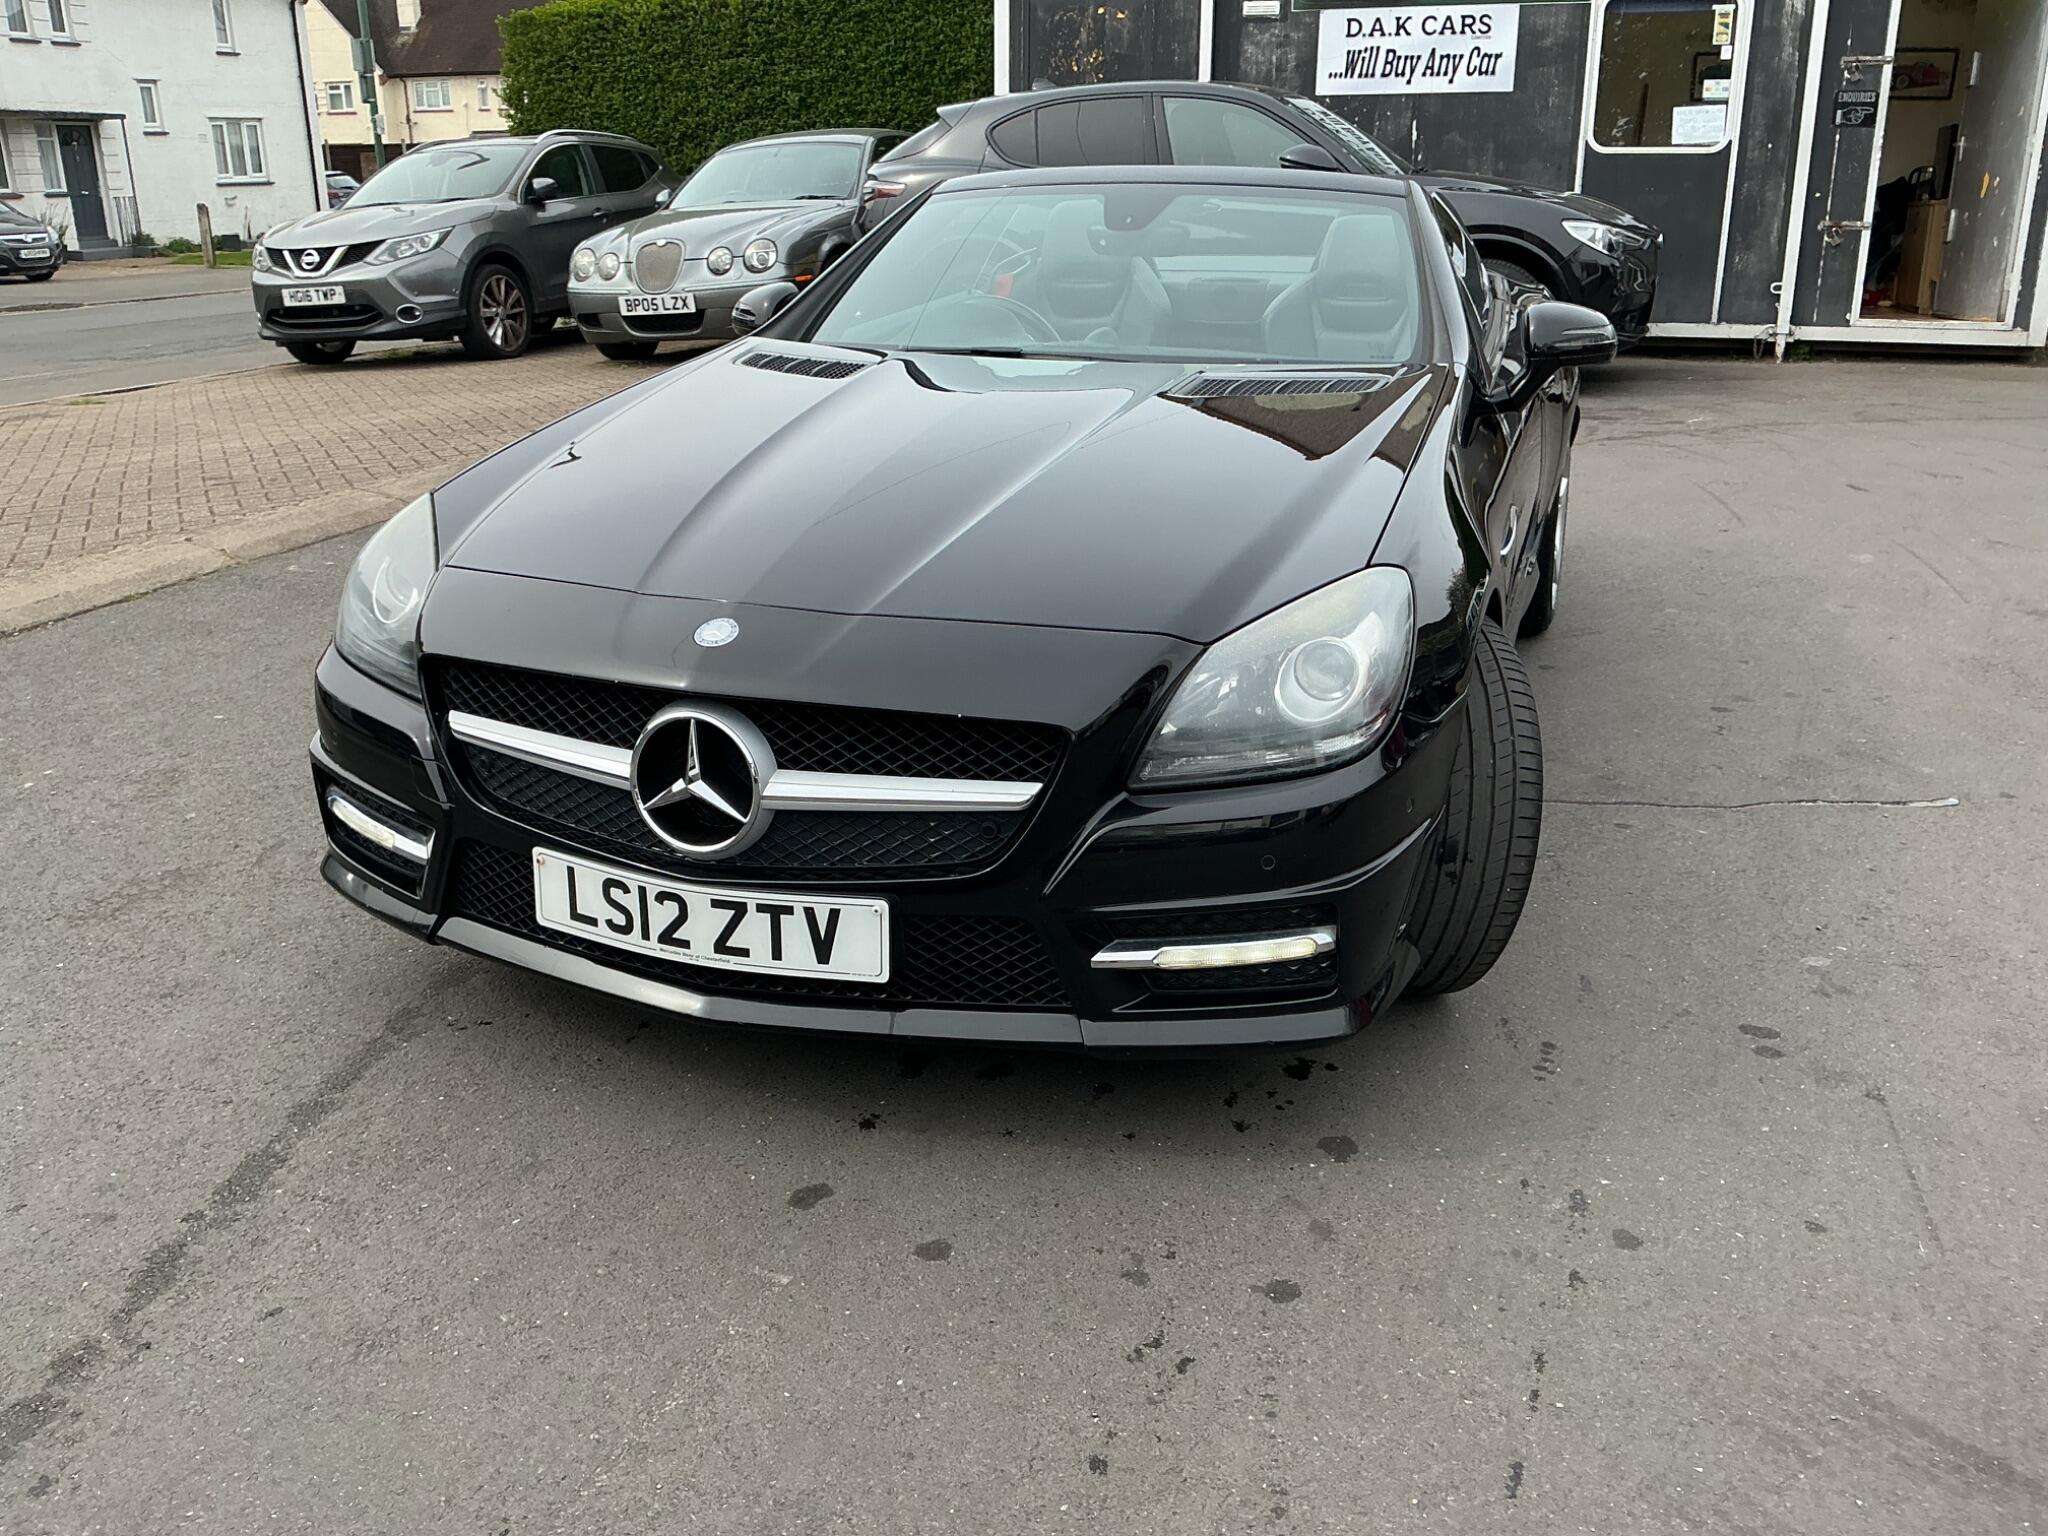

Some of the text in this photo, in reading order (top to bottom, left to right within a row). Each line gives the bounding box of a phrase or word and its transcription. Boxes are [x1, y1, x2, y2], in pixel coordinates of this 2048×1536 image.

[1346, 14, 1493, 38] D.A.K CARS
[1380, 48, 1422, 85] Buy
[1421, 48, 1464, 84] Any
[1466, 46, 1503, 77] Car
[314, 287, 336, 301] TWP
[624, 295, 690, 312] BP05 LZX
[566, 865, 841, 965] LS12 ZTV
